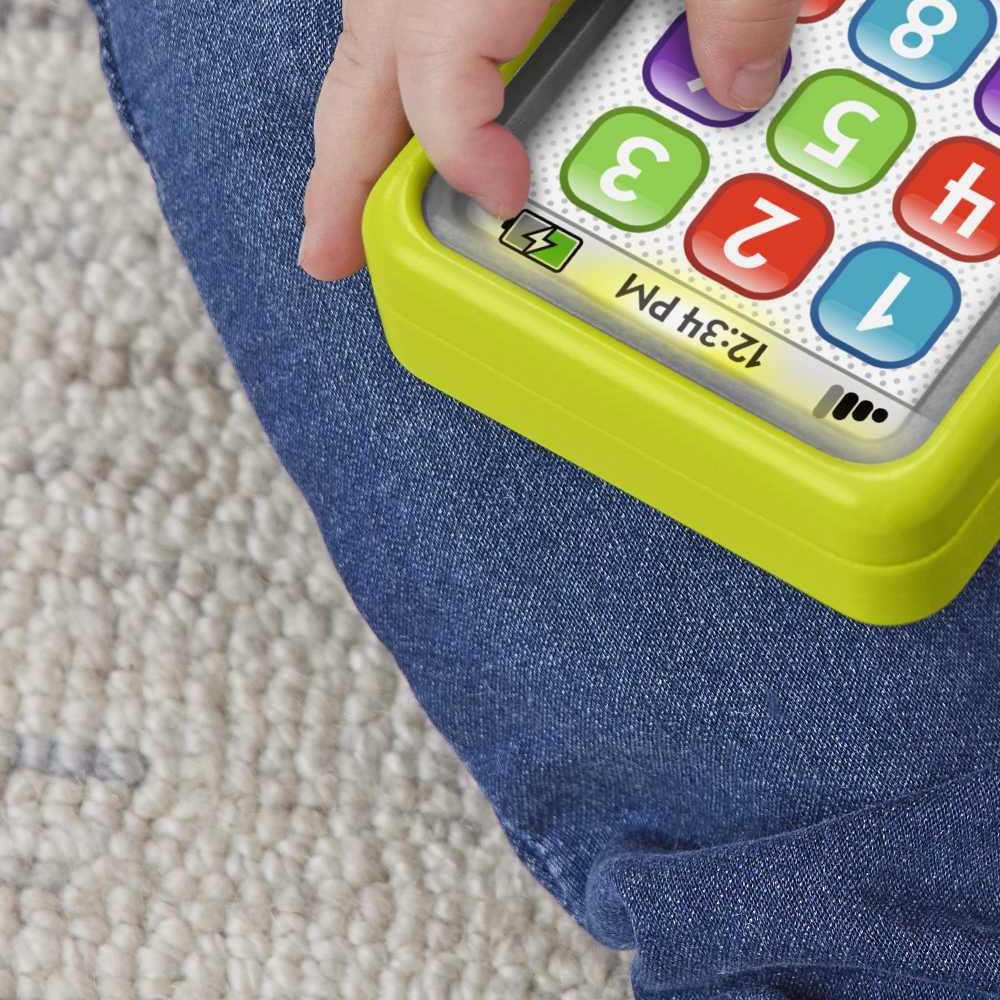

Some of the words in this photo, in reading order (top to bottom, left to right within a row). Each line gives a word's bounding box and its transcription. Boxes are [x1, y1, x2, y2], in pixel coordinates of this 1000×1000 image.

[803, 100, 881, 168] 5
[599, 136, 671, 201] 3
[929, 161, 996, 239] 4
[723, 196, 800, 268] 2
[614, 272, 681, 323] PM
[855, 271, 911, 332] 1
[677, 306, 769, 369] 12:34
